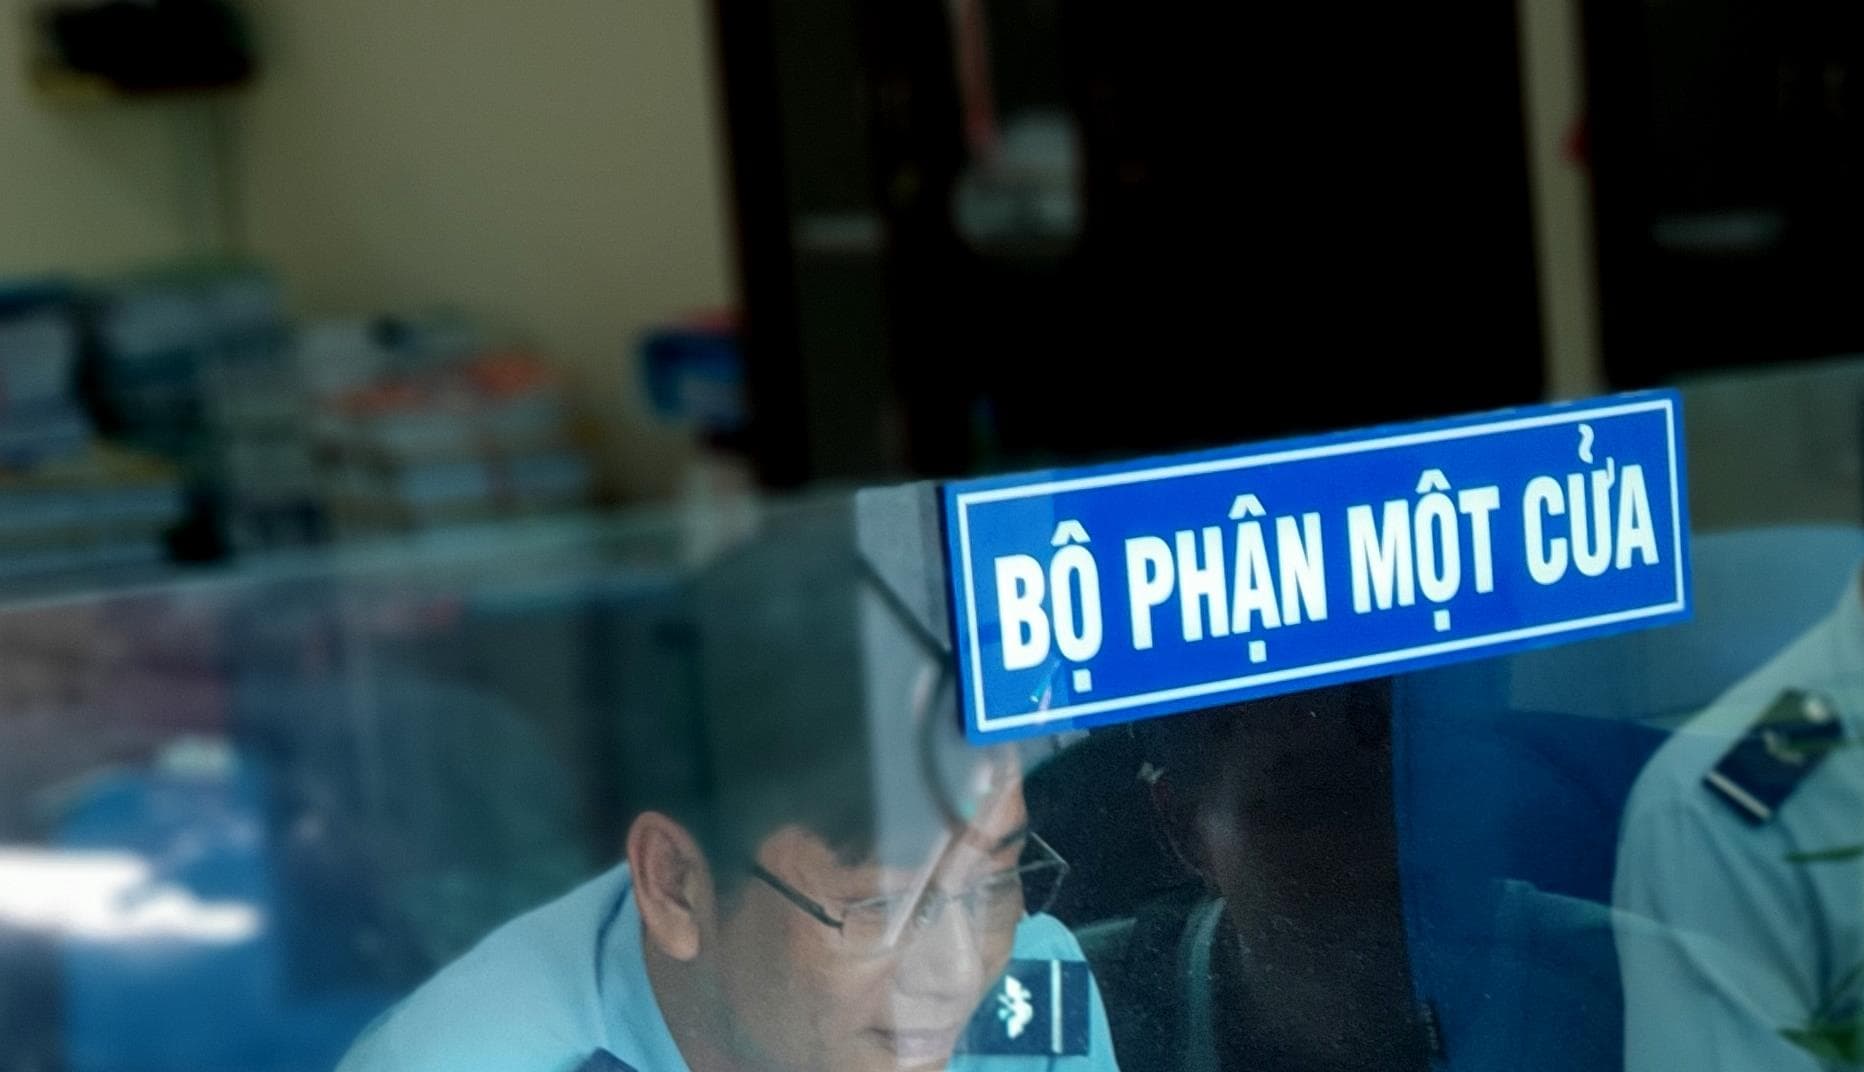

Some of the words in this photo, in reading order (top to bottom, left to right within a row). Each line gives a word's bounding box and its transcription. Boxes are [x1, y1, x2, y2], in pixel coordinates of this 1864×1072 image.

[994, 519, 1103, 693] BỘ
[1124, 494, 1328, 663] PHẬN
[1347, 469, 1501, 631] MỘT
[1524, 423, 1659, 586] CỬA
